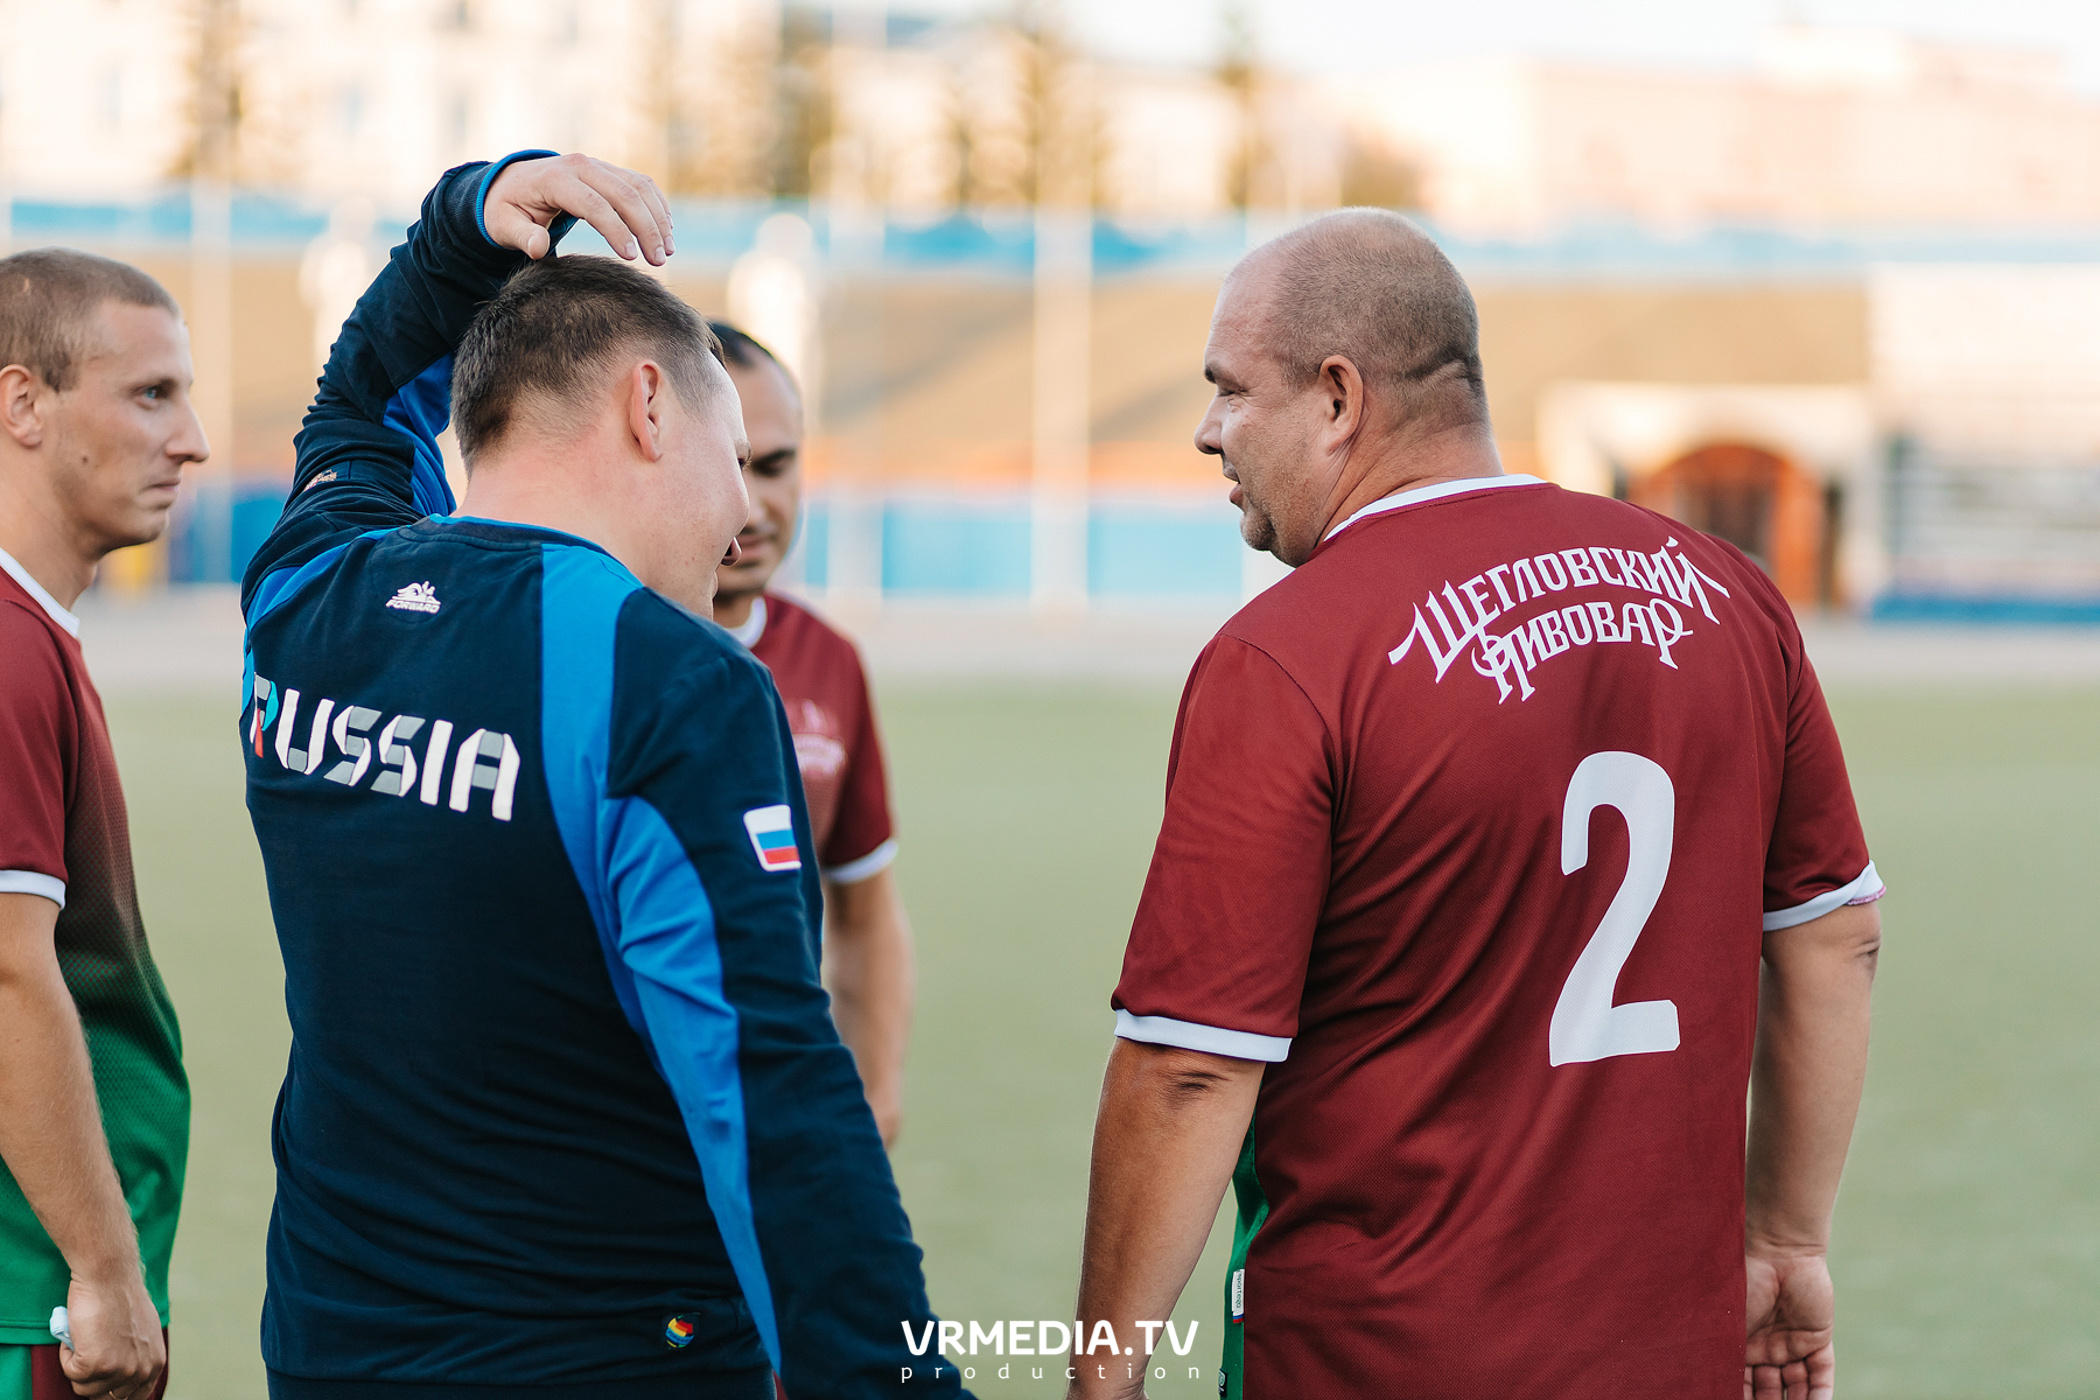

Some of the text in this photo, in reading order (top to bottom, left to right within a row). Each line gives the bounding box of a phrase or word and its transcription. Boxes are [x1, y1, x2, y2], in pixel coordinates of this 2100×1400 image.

[1388, 536, 1730, 684] ЩЕГЛОВСКИЙ
[1471, 598, 1693, 705] ПИВОВАР
[250, 672, 520, 821] RUSSIA
[1549, 751, 1680, 1067] 2
